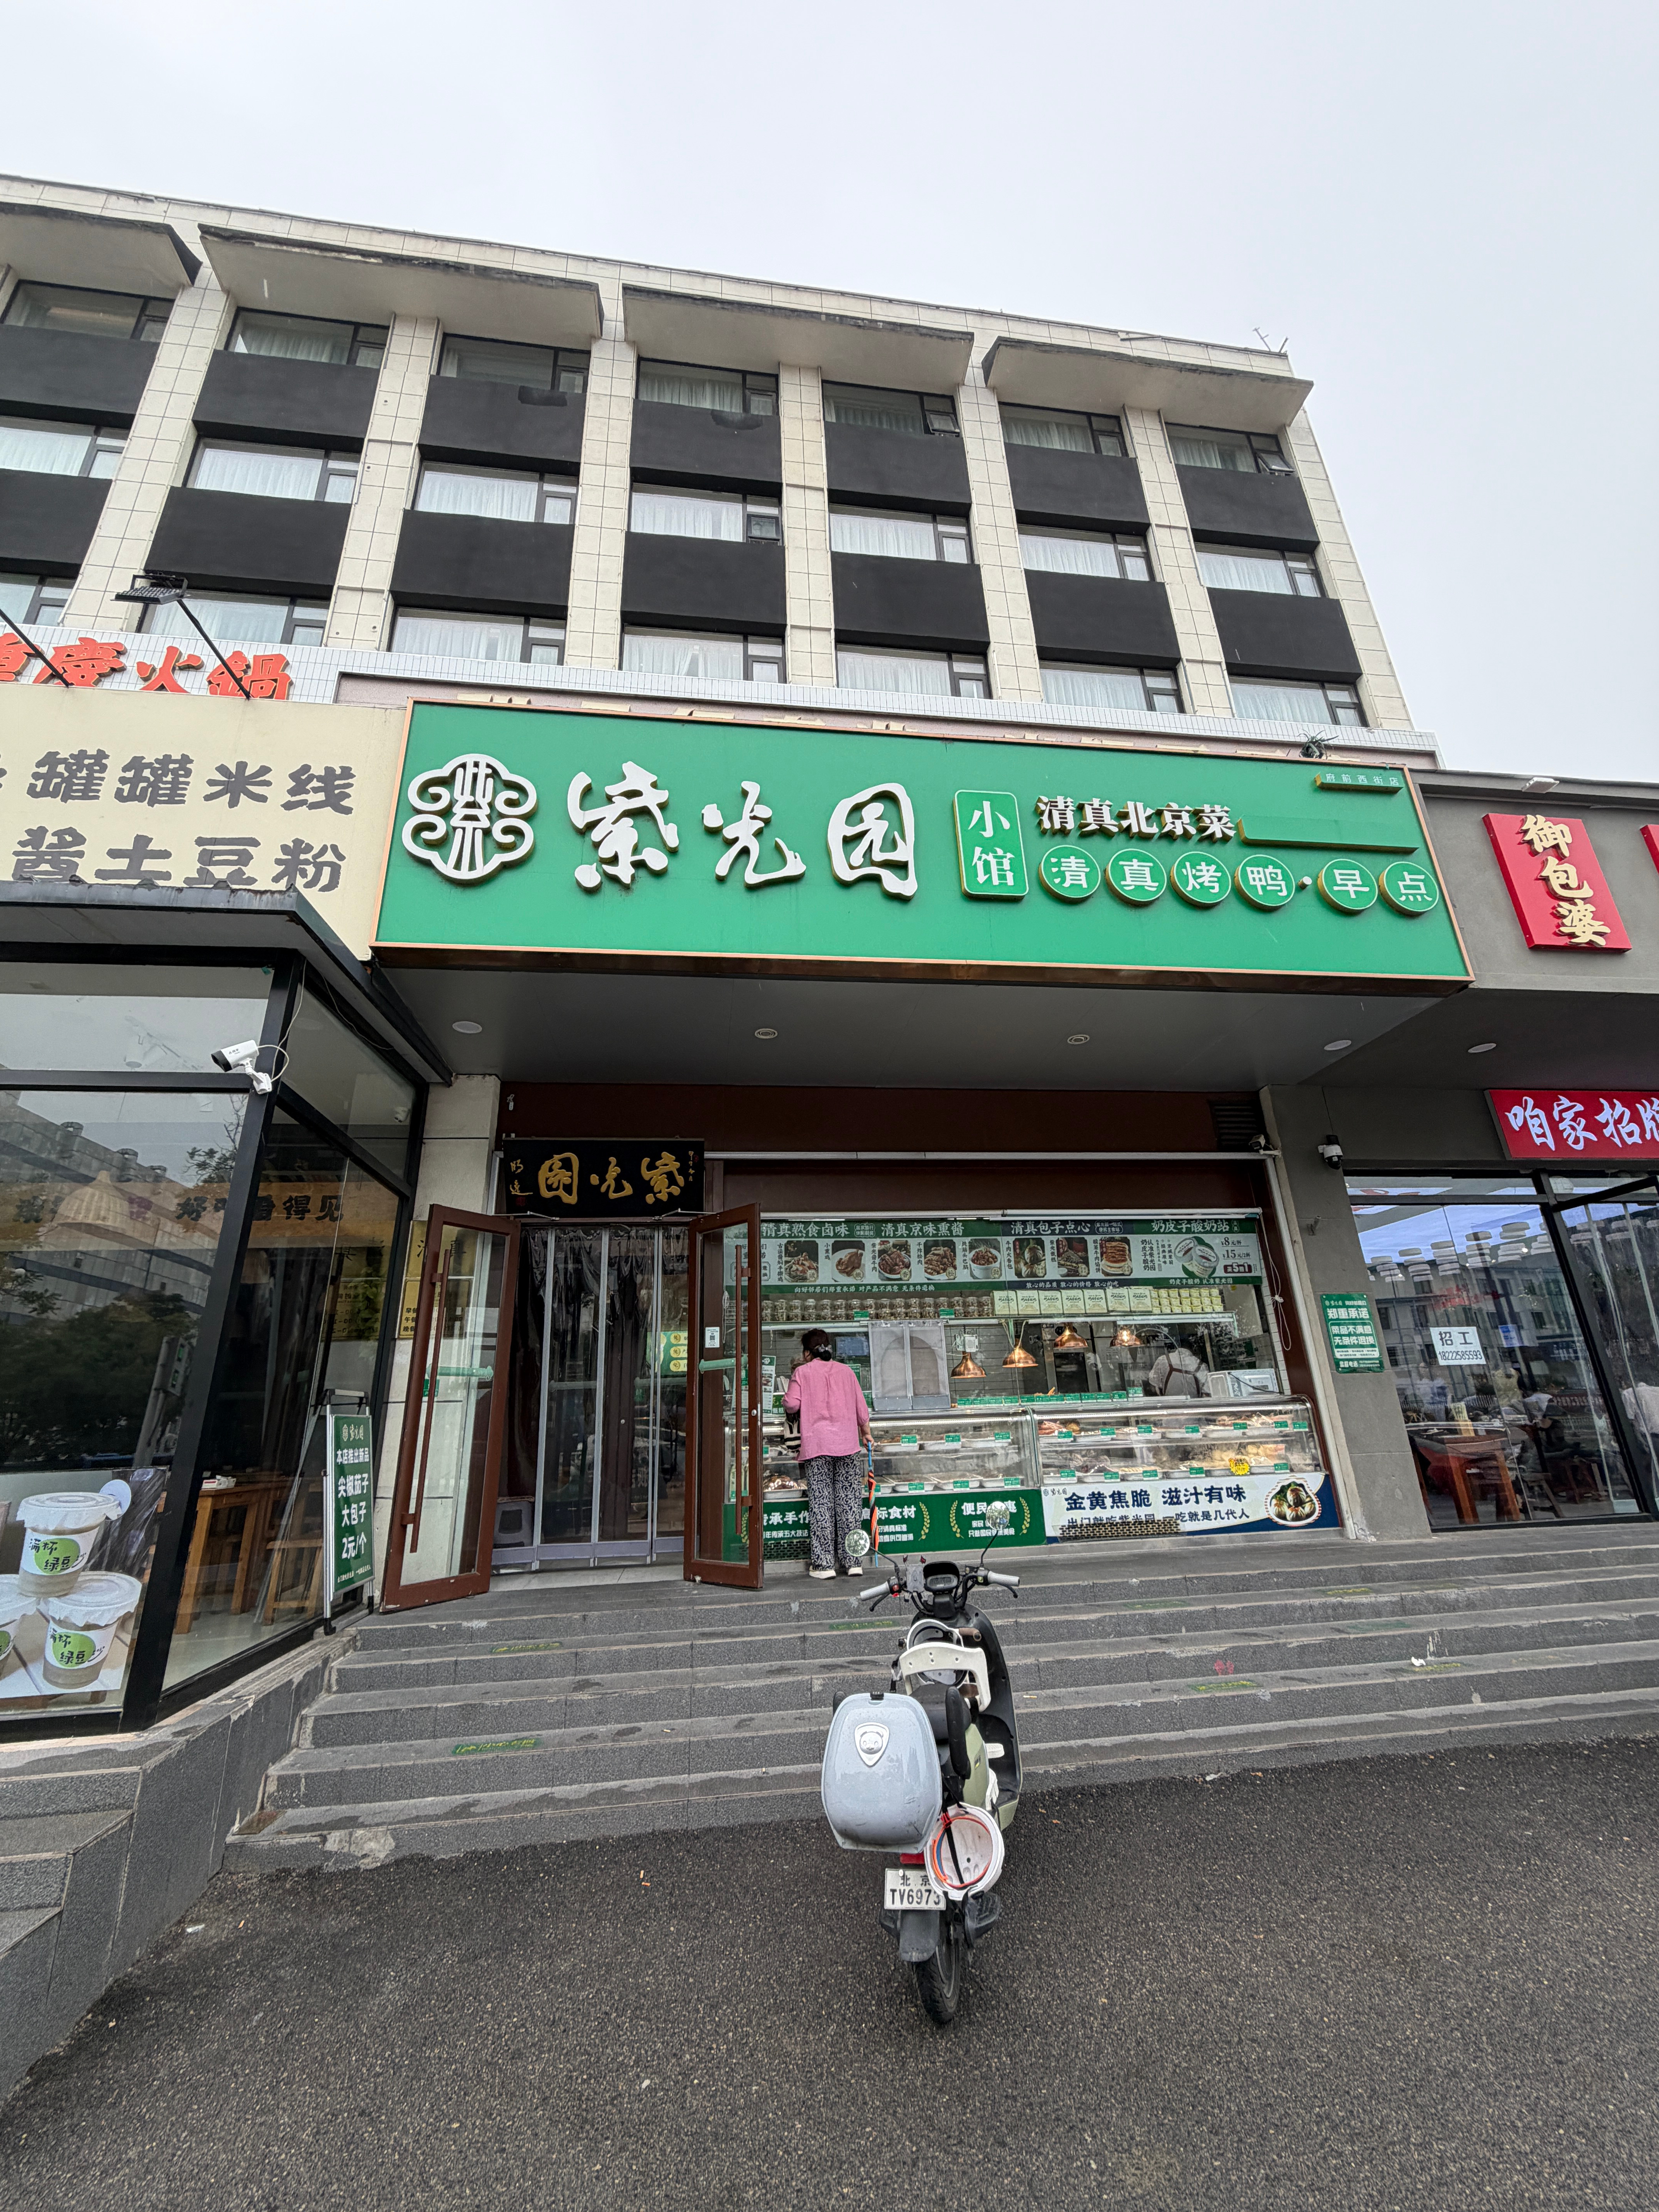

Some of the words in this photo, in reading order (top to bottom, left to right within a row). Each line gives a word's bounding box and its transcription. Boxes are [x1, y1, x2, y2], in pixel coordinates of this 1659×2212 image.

[1326, 773, 1399, 786] 府前西街店
[1036, 795, 1236, 840] 清真北京菜
[567, 761, 918, 901] 紫光园
[968, 800, 1016, 887] 小馆
[12, 826, 346, 892] 酱土豆粉
[1522, 814, 1611, 946] 御包婆
[761, 1222, 850, 1237] 清真熟食卤味
[881, 1221, 965, 1237] 清真京味熏酱
[1010, 1221, 1091, 1235] 清真包子点心
[1151, 1219, 1230, 1233] 奶皮子酸奶站
[1140, 1239, 1150, 1271] 奶皮子酸奶
[1147, 1239, 1156, 1271] 认准紫光园
[1327, 1308, 1369, 1319] 郑重承诺
[1331, 1325, 1373, 1334] 菜品不满意
[1333, 1336, 1375, 1345] 无条件退换
[1439, 1331, 1473, 1346] 招工
[1438, 1350, 1482, 1360] 18222585593
[337, 1448, 369, 1465] 本店推出新品
[338, 1473, 369, 1498] 尖椒茄子
[1064, 1489, 1152, 1512] 金黄焦脆
[1161, 1484, 1246, 1506] 滋汁有味
[342, 1501, 366, 1527] 大包子
[961, 1500, 1017, 1516] 便民惠
[1162, 1508, 1250, 1523] 一吃就是几代人
[763, 1529, 809, 1539] 年传承五大技法
[342, 1532, 367, 1559] 2元/个
